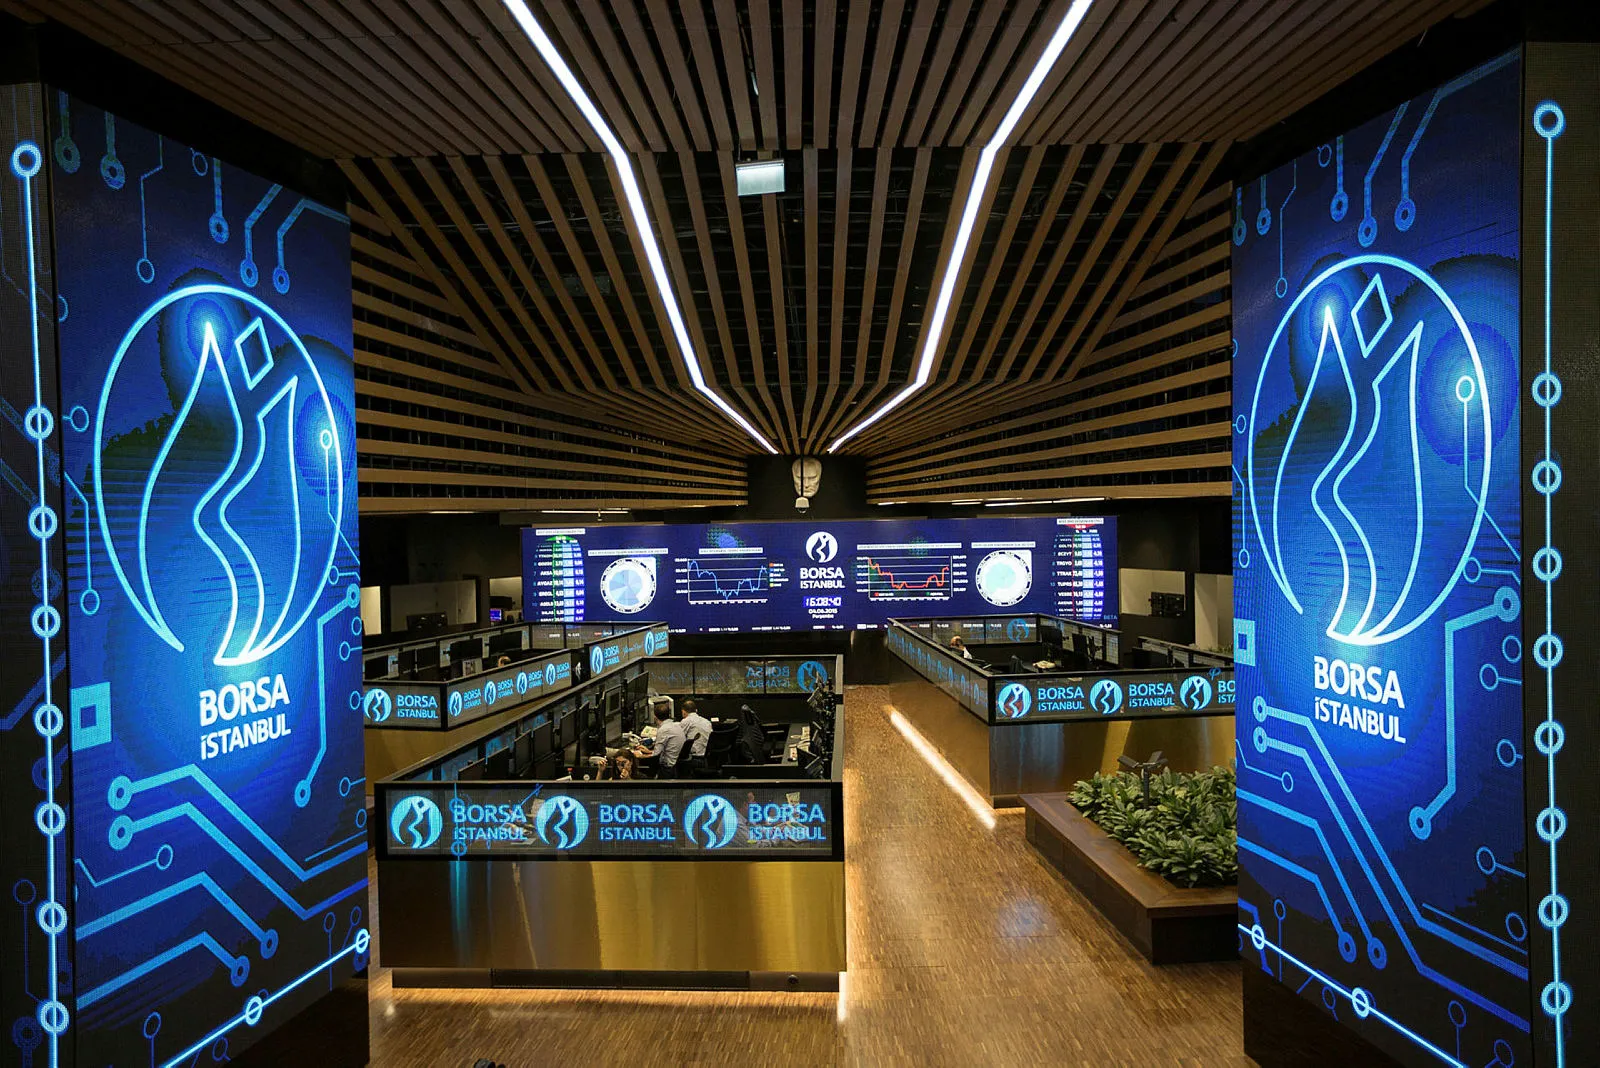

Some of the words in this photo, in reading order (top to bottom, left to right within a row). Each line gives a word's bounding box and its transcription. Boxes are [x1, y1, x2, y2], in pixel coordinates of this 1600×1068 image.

[800, 567, 845, 579] BORSA
[1129, 681, 1175, 697] BORSA
[1314, 655, 1406, 709] BORSA
[199, 673, 291, 727] BORSA
[396, 694, 438, 708] BORSA
[463, 687, 481, 702] BORSA
[1038, 686, 1085, 701] BORSA
[453, 803, 527, 824] BORSA
[600, 803, 674, 824] BORSA
[749, 803, 825, 824] BORSA
